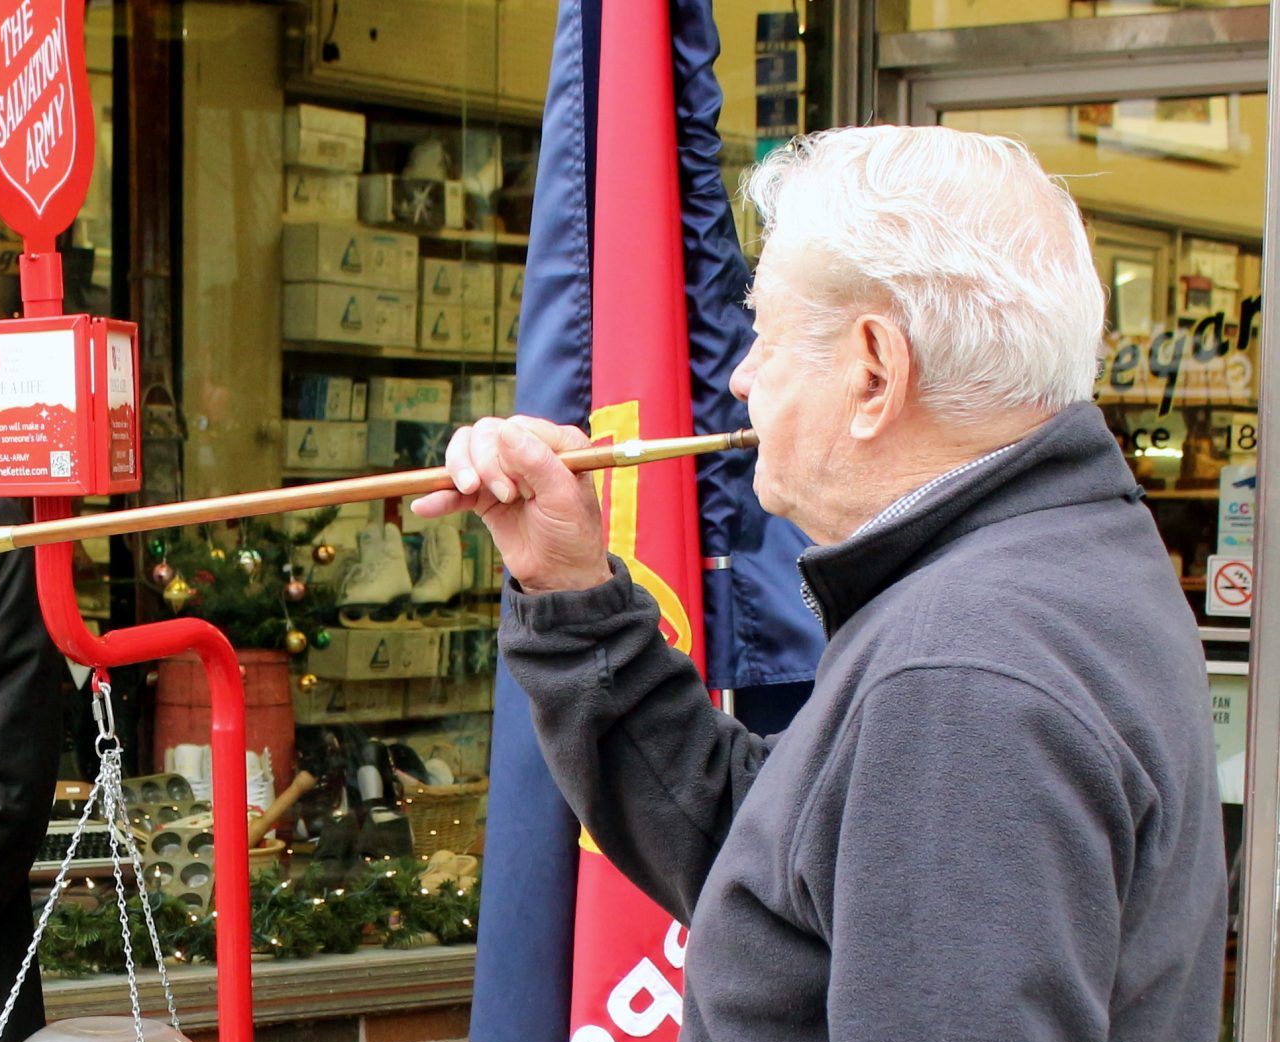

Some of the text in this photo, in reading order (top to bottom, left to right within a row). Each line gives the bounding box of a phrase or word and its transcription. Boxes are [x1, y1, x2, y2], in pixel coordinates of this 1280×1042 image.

[0, 0, 33, 67] THE
[25, 83, 65, 184] ARMY
[11, 381, 19, 395] A
[21, 379, 45, 394] LIFE
[9, 422, 20, 431] will
[22, 422, 39, 431] make
[1, 433, 34, 443] someone's
[1225, 424, 1257, 450] 18
[1213, 696, 1231, 709] FAN
[1213, 711, 1230, 725] KER
